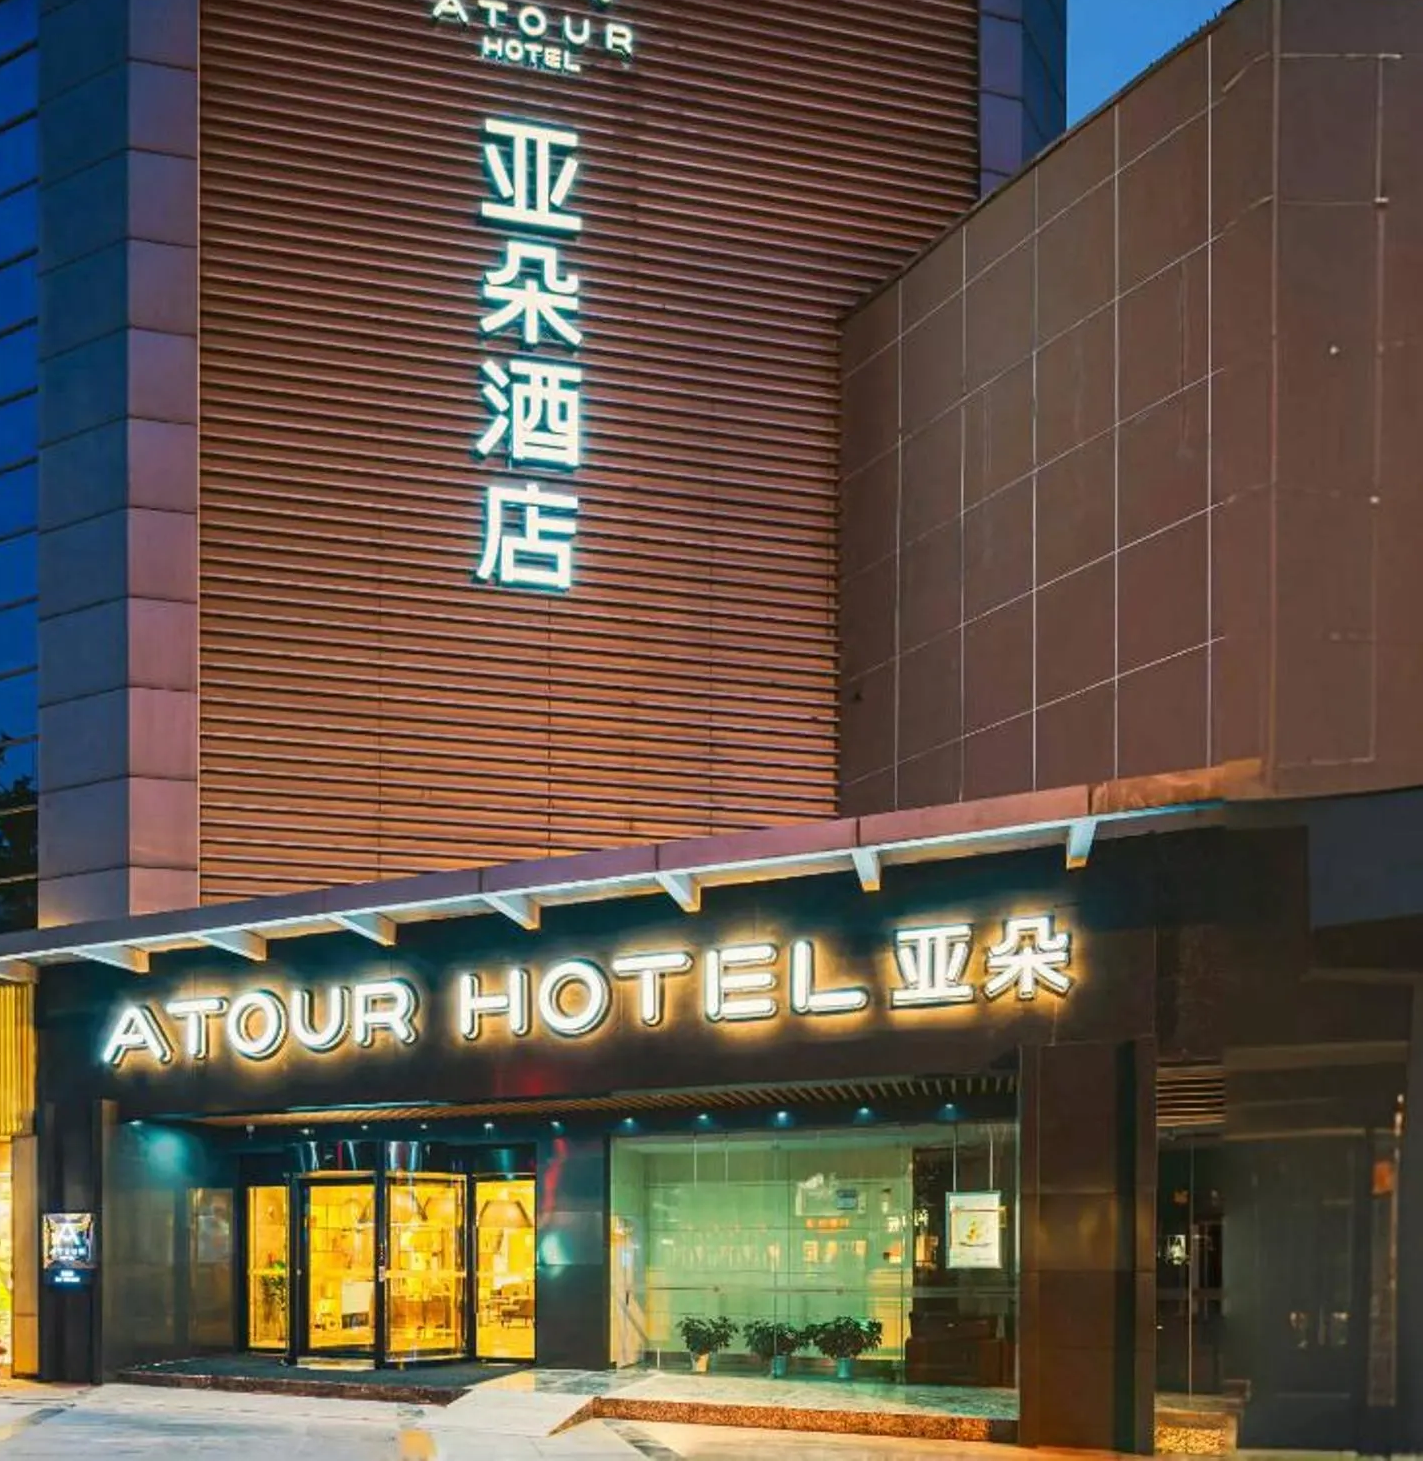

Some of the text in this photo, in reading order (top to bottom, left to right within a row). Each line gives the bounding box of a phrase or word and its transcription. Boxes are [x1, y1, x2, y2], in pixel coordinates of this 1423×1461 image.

[482, 36, 582, 73] HOTEL
[476, 117, 584, 589] 亚朵酒店
[101, 916, 1072, 1066] ATOUR HOTEL 亚朵
